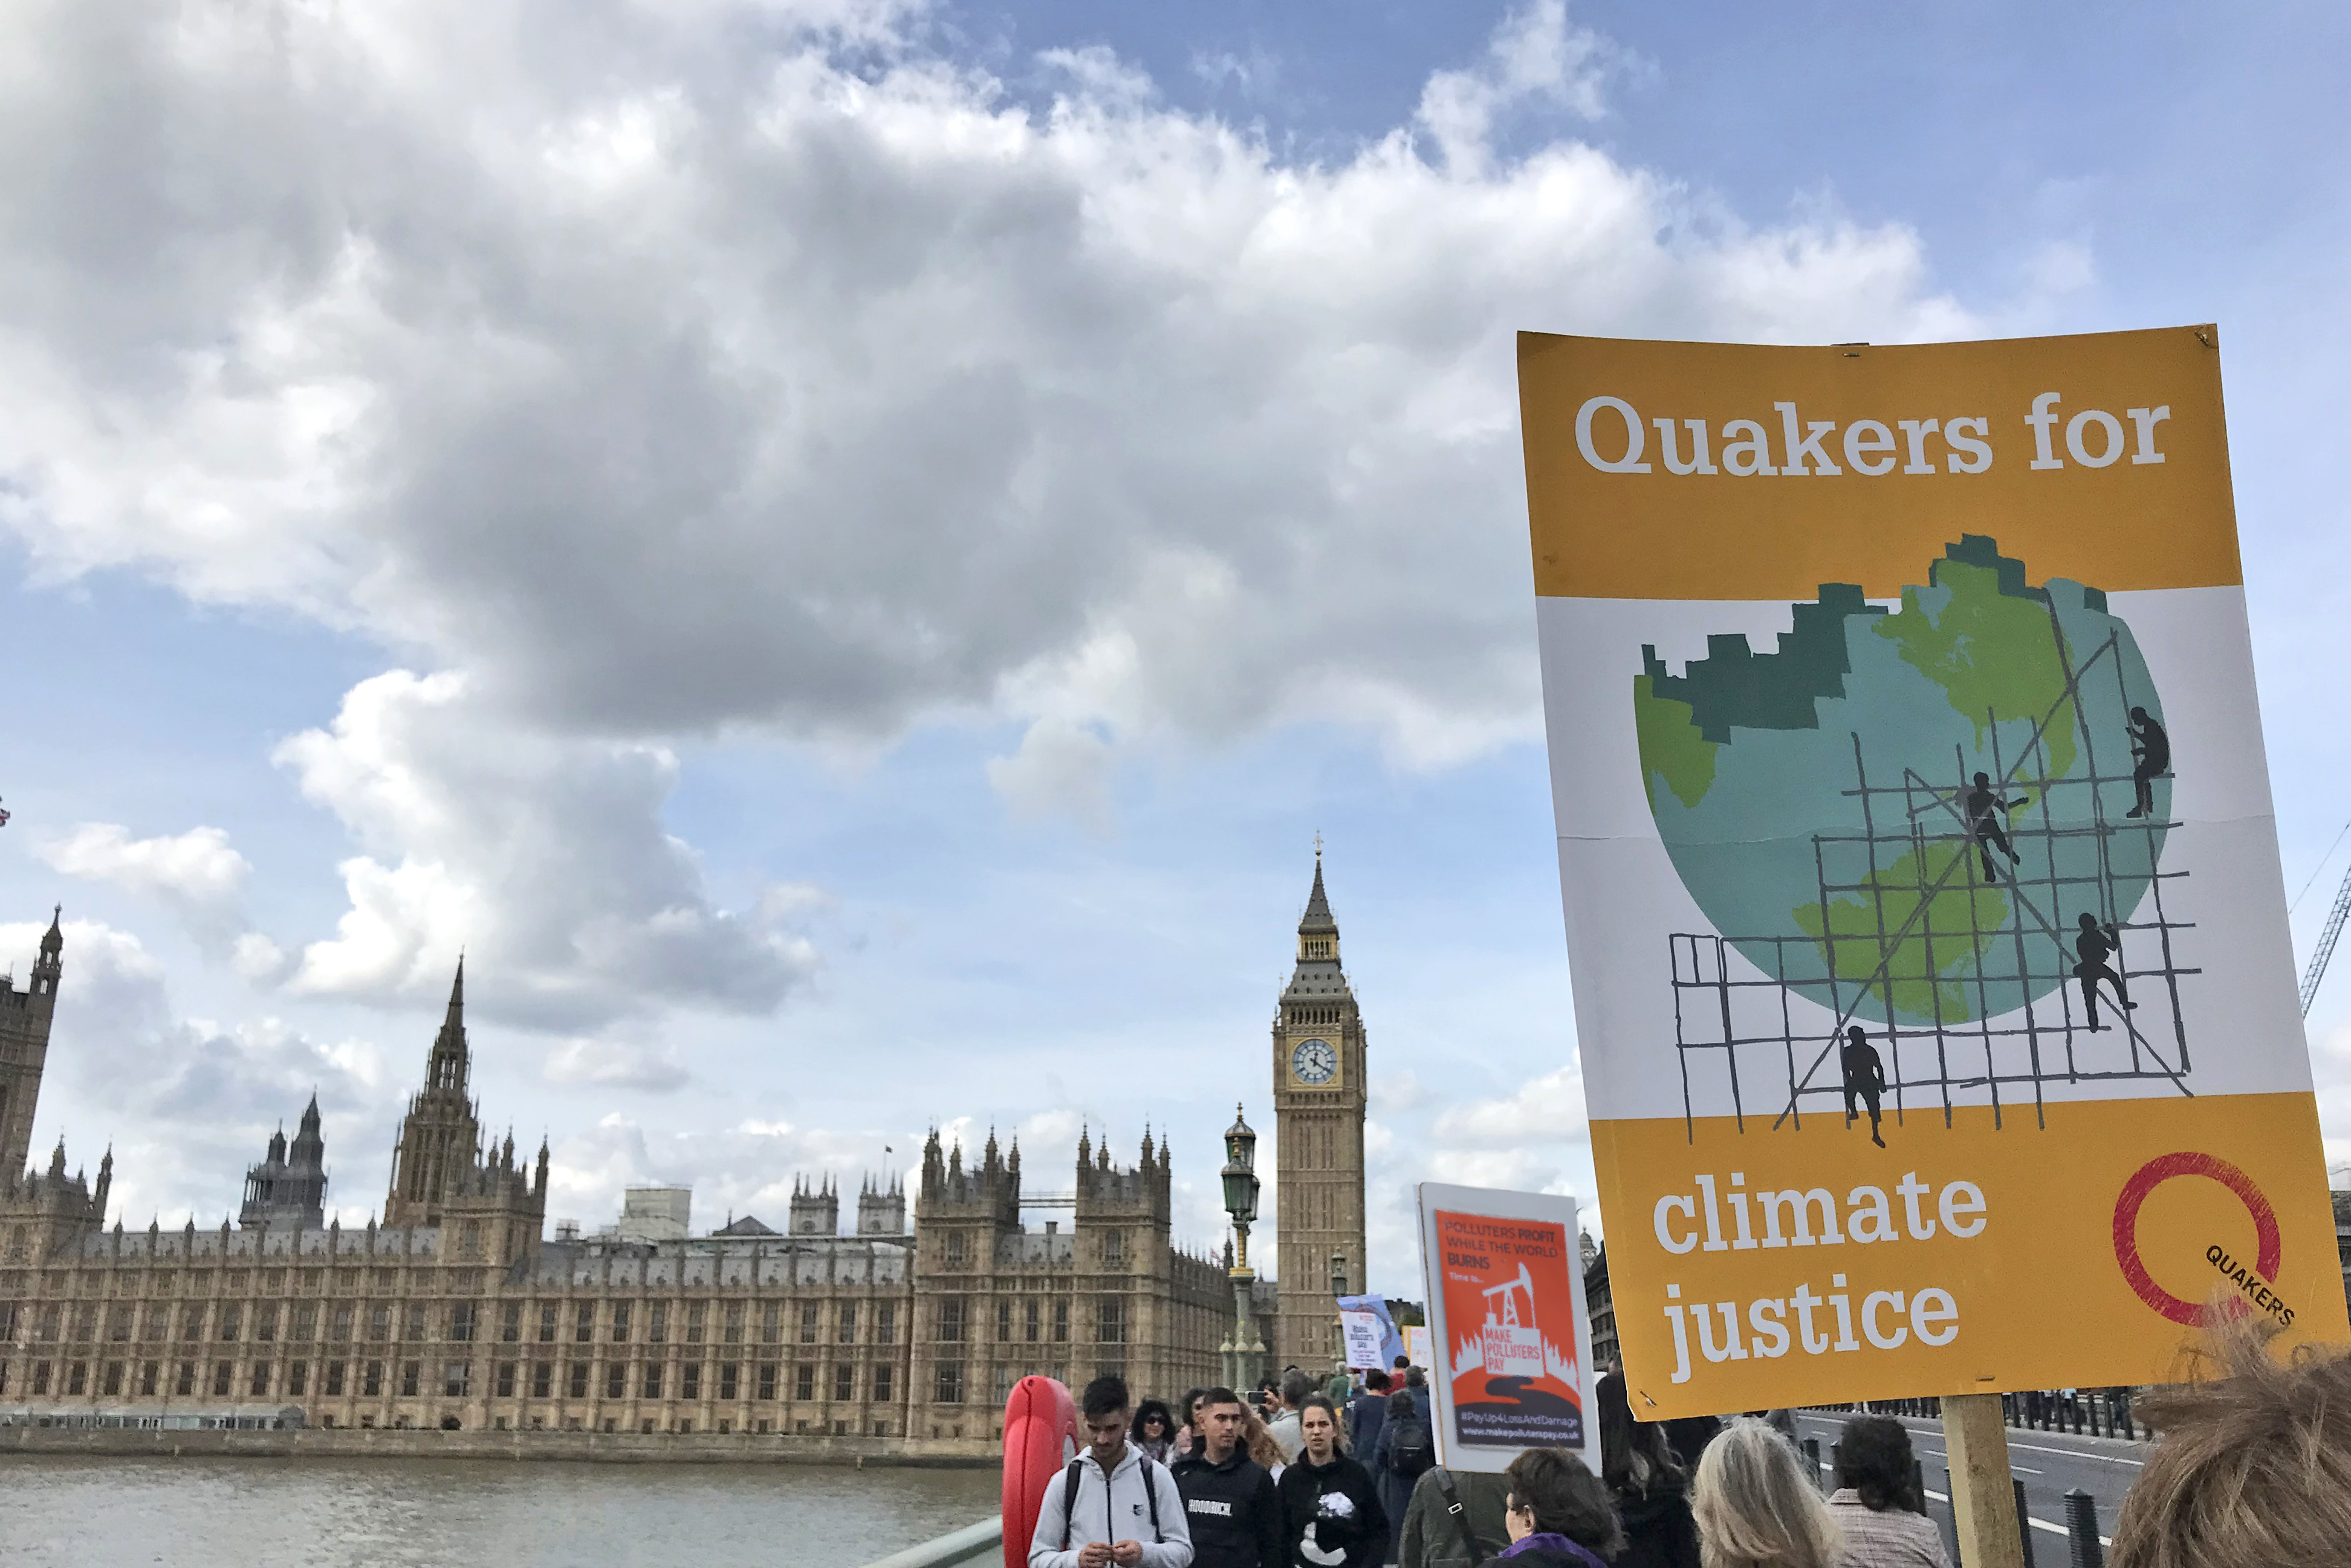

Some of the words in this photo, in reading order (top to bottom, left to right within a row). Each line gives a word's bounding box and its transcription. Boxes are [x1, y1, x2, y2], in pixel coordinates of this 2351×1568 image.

[1575, 396, 1993, 476] Quakers
[2024, 392, 2171, 471] for
[1653, 1171, 1987, 1254] climate
[1445, 1220, 1516, 1239] POLLUTERS
[1518, 1228, 1555, 1242] PROFIT
[1446, 1236, 1486, 1252] WHILE
[1489, 1241, 1511, 1254] THE
[1513, 1243, 1558, 1258] WORLD
[1447, 1252, 1490, 1269] BURNS
[2206, 1245, 2295, 1327] QUAKERS
[1485, 1327, 1512, 1343] MAKE
[1664, 1274, 1959, 1384] justice
[1487, 1343, 1540, 1360] POLLUTERS
[1488, 1357, 1504, 1371] PAY
